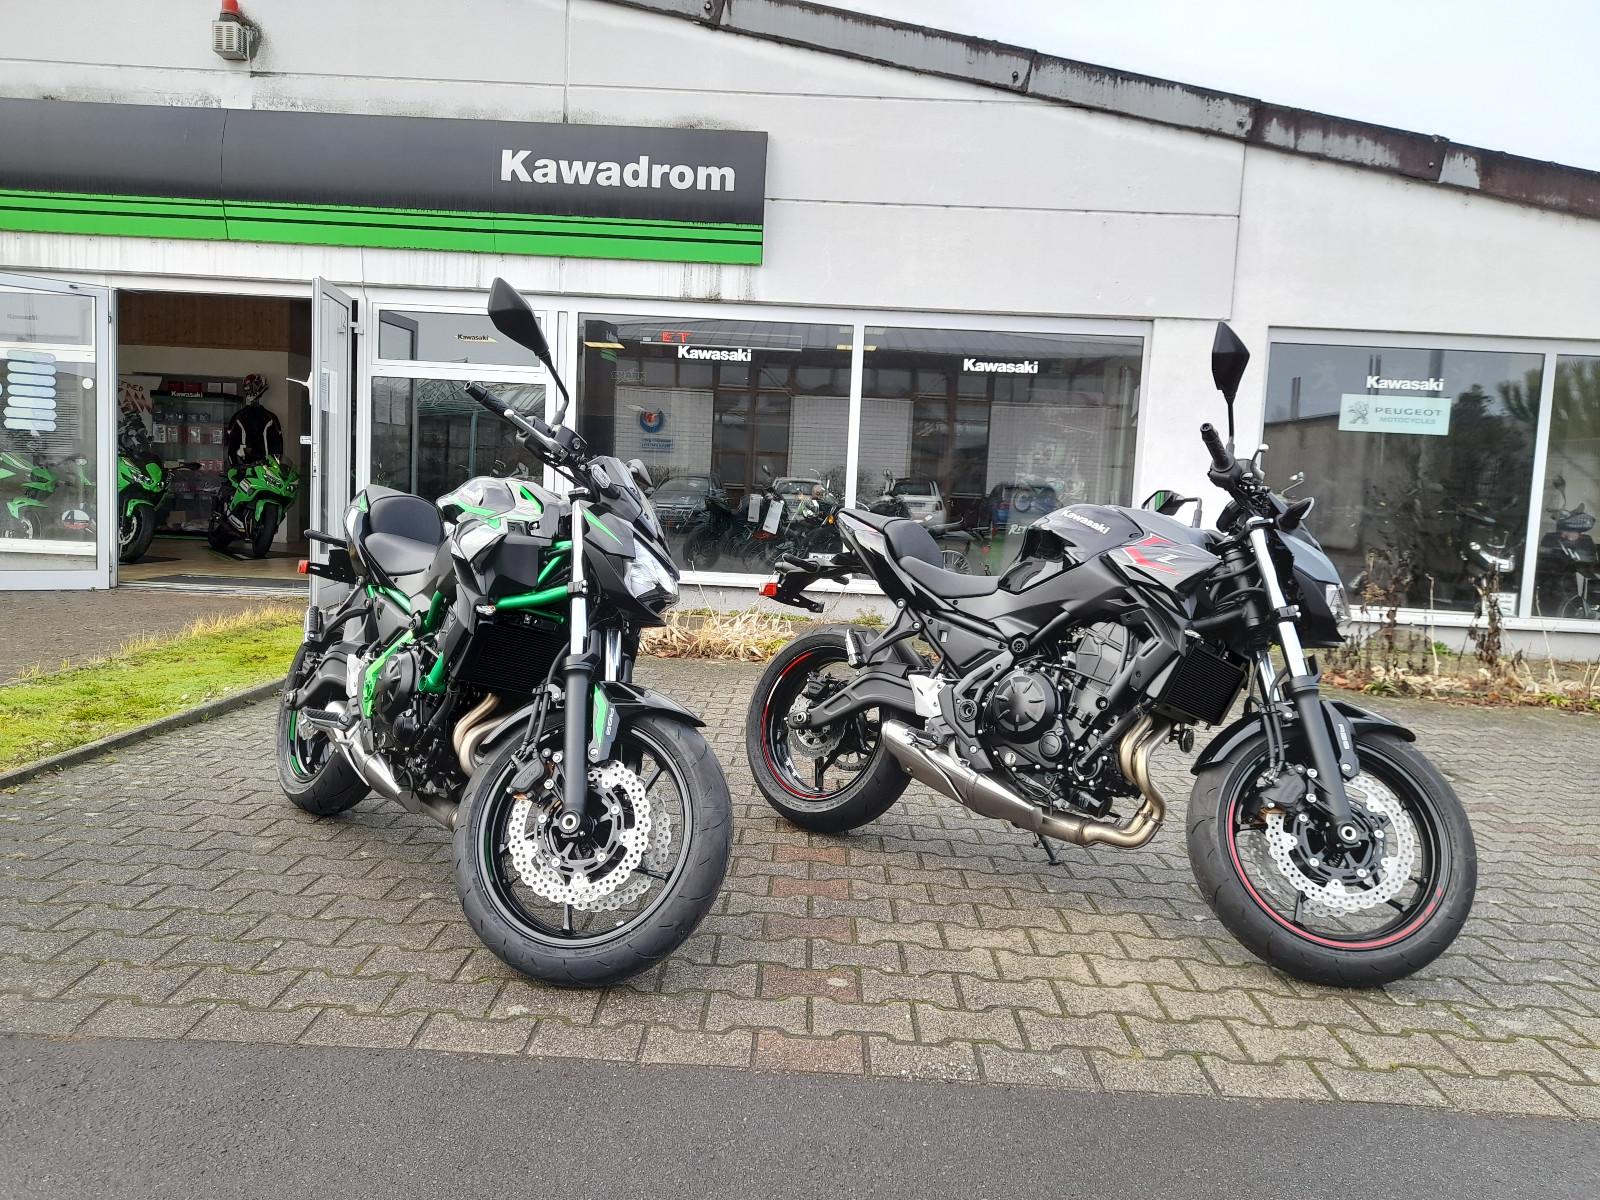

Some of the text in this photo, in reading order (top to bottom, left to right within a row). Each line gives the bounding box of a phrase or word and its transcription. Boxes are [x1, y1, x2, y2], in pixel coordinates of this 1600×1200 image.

[500, 149, 735, 192] Kawadrom
[457, 333, 489, 341] Kawasaki
[677, 345, 752, 362] Kawasaki
[963, 358, 1039, 374] Kawasaki
[1366, 375, 1445, 391] Kawasaki
[1375, 407, 1443, 416] PEUGEOT
[1060, 509, 1111, 535] Kawasaki
